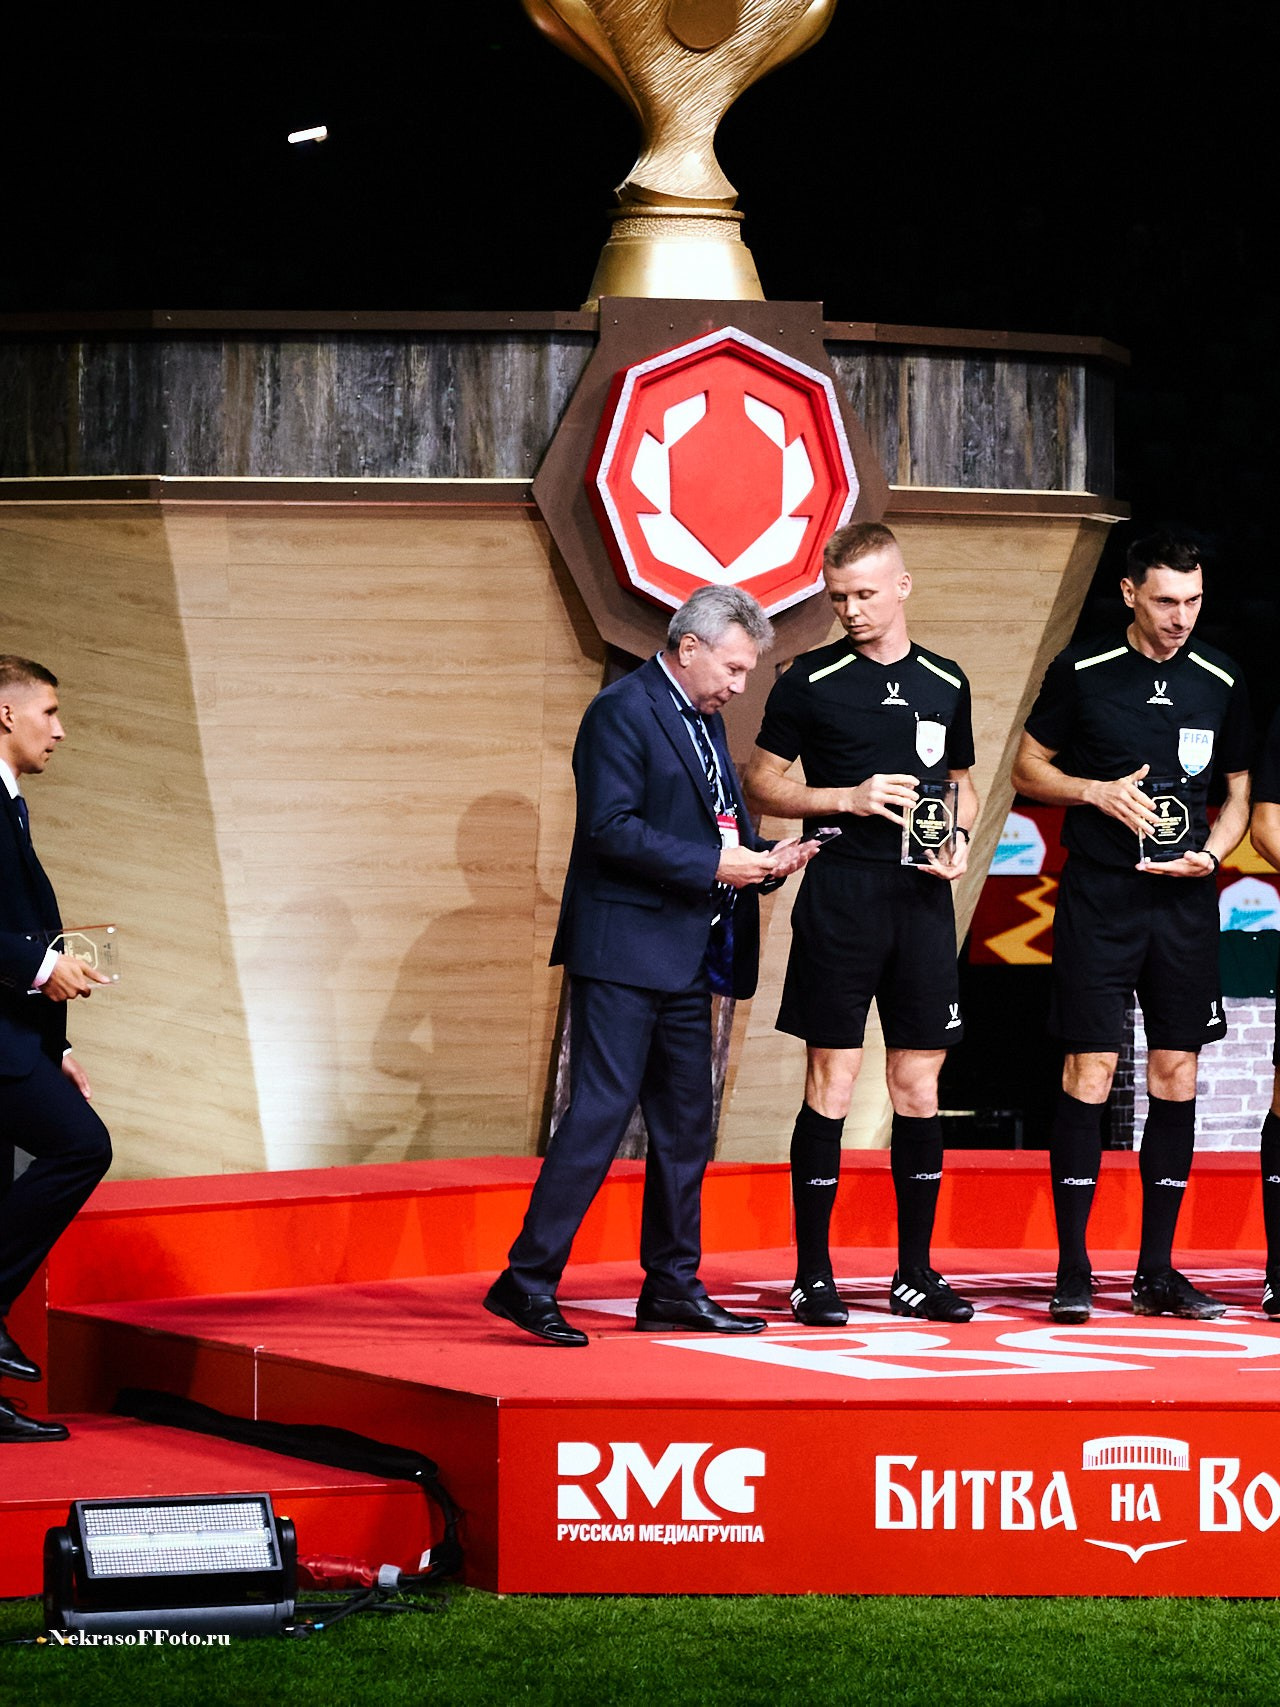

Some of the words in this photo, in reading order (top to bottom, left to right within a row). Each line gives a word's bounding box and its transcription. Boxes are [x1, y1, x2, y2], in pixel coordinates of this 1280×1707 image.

[1183, 732, 1209, 745] FIFA
[1060, 1177, 1096, 1186] JÖGEL
[557, 1441, 766, 1521] RMG
[557, 1523, 635, 1545] РУССКАЯ
[638, 1523, 765, 1547] МЕДИАГРУППА
